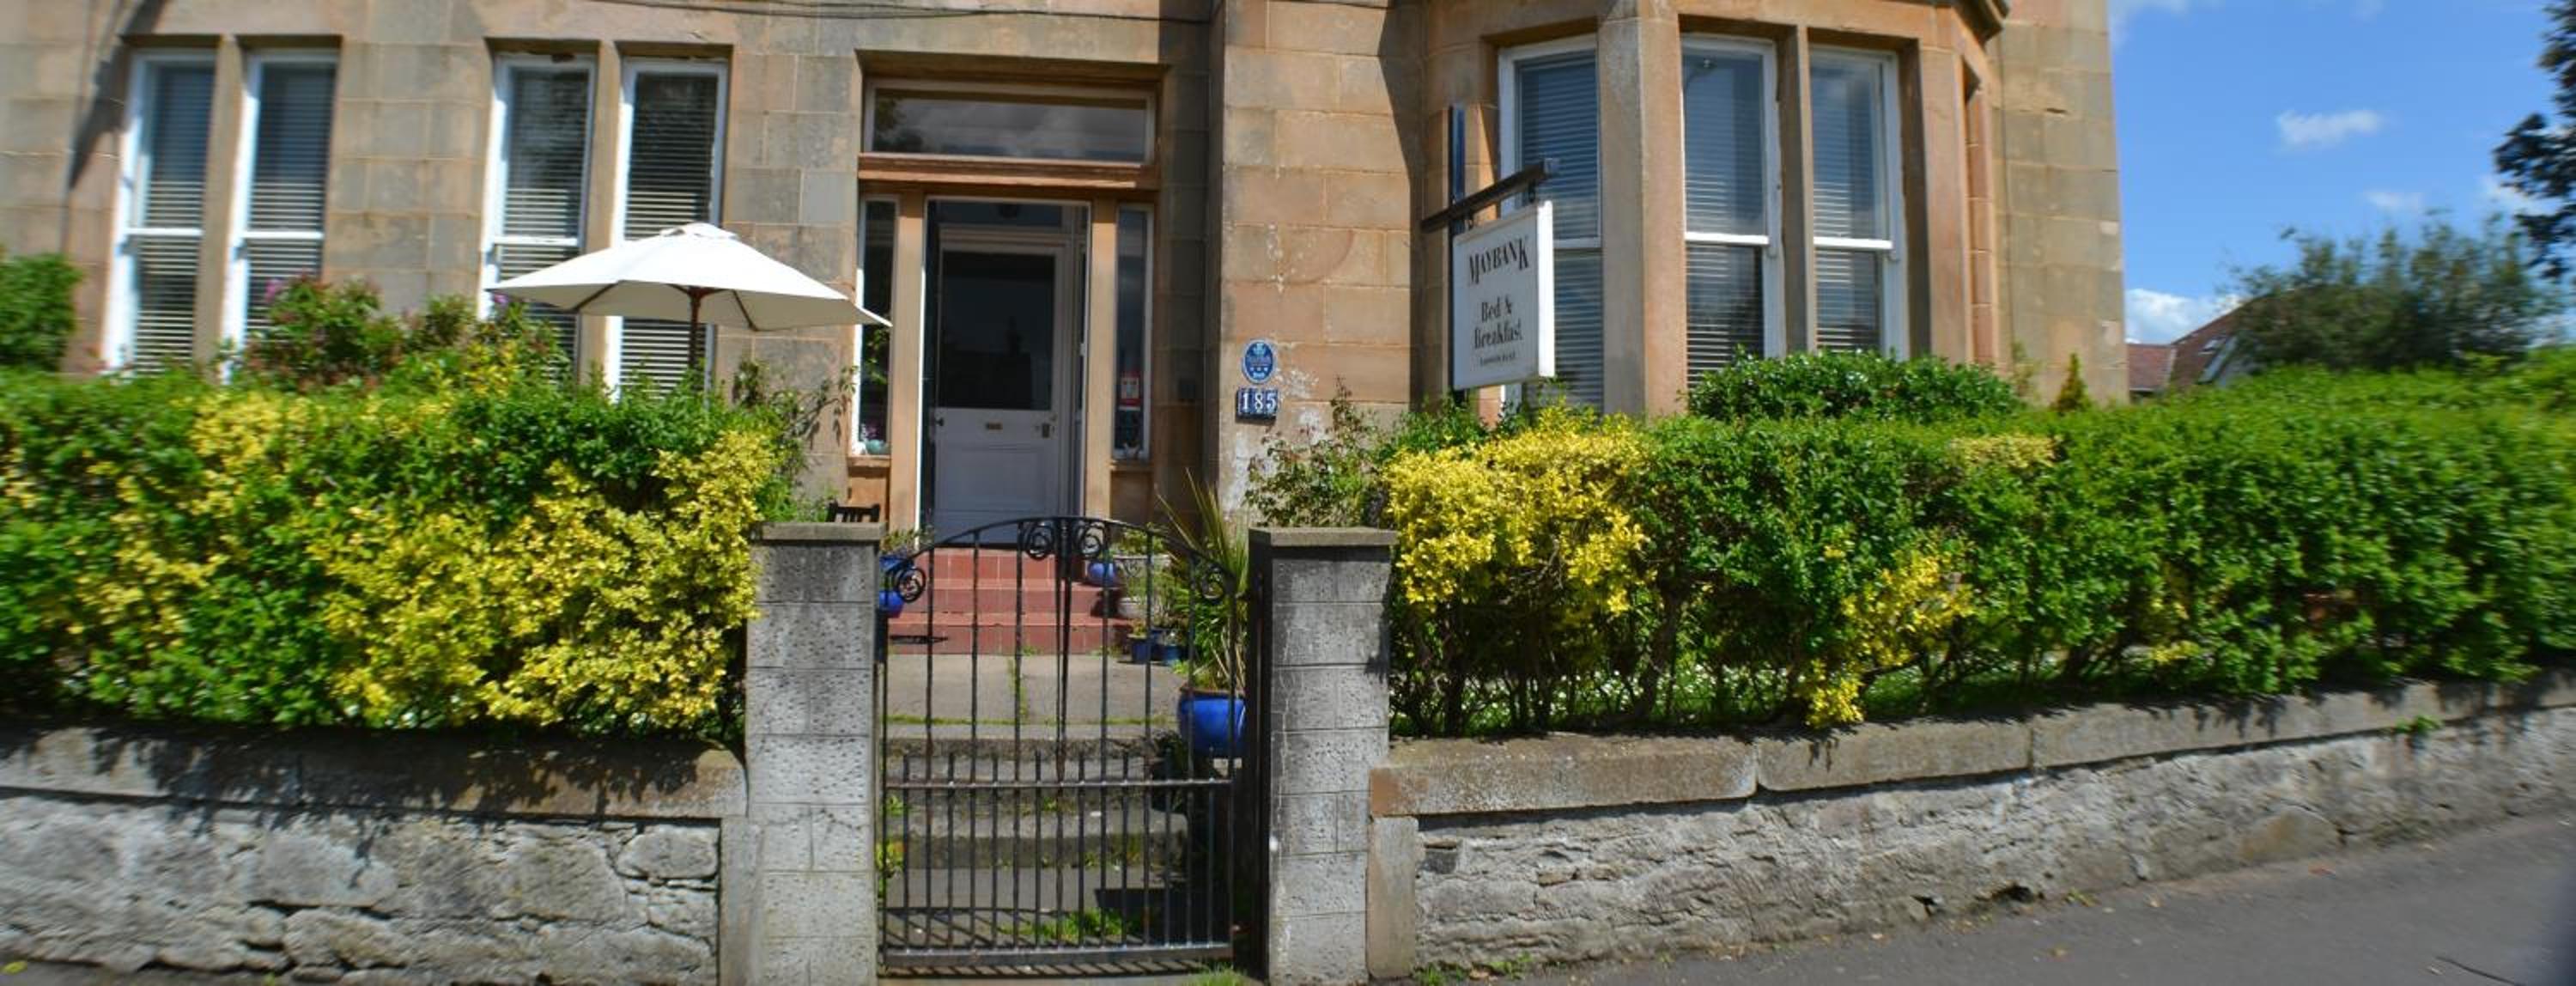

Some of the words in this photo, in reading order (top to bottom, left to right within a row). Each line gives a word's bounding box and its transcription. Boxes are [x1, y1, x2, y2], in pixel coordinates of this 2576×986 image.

[1468, 237, 1529, 284] MAYBANK
[1481, 296, 1500, 322] Bed
[1504, 295, 1512, 314] &
[1474, 319, 1522, 350] Breakfast
[1242, 392, 1277, 411] 185
